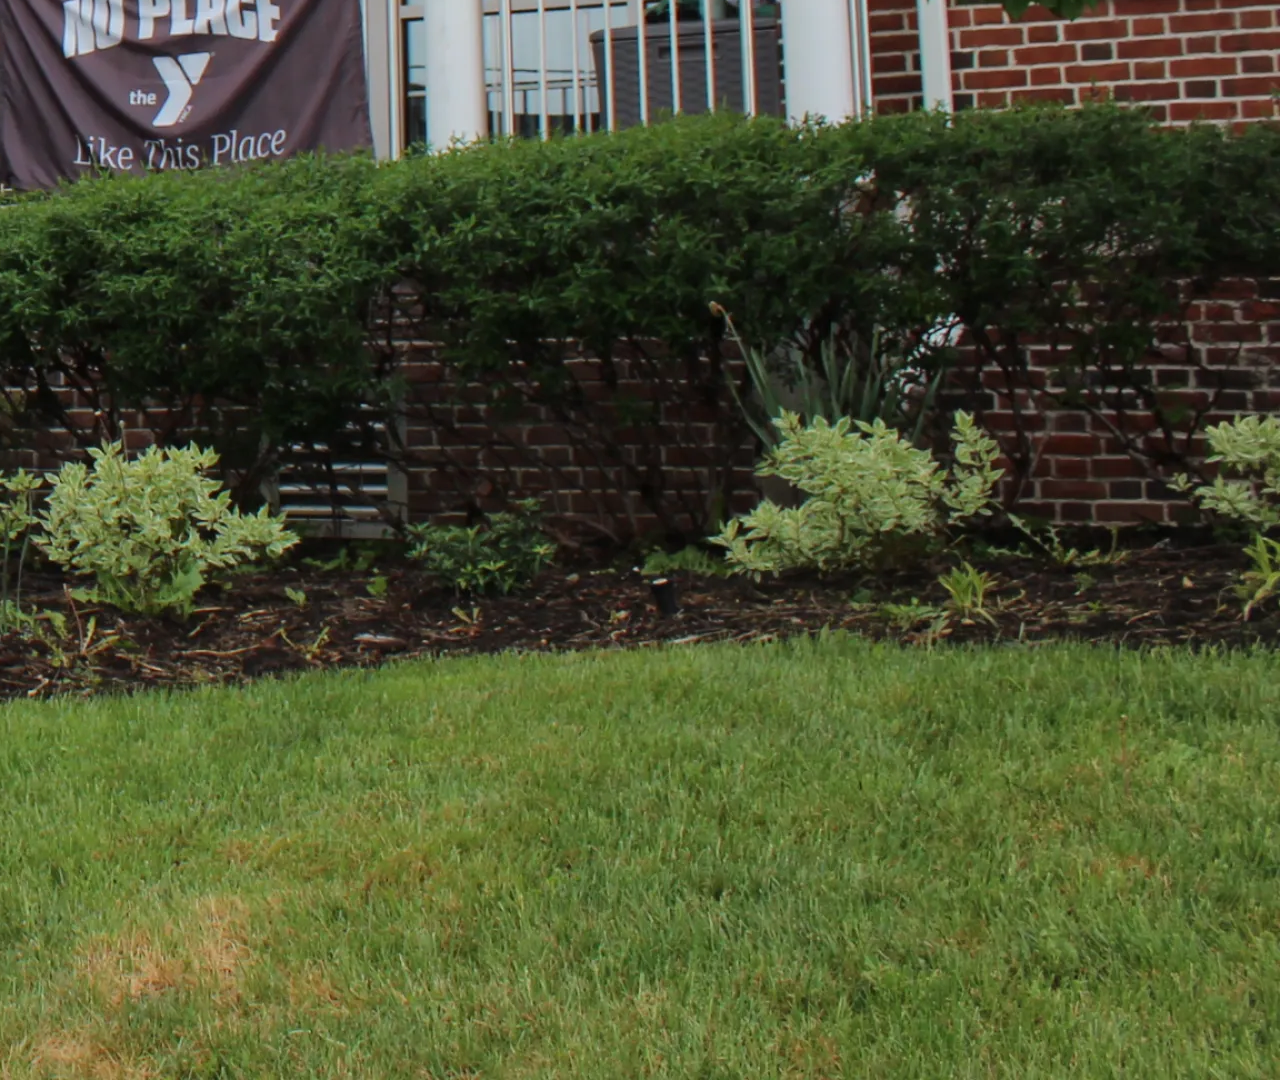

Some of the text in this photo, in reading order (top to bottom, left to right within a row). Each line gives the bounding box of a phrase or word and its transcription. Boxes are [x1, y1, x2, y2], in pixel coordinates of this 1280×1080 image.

[129, 89, 157, 105] the
[73, 129, 286, 170] Like This Place
